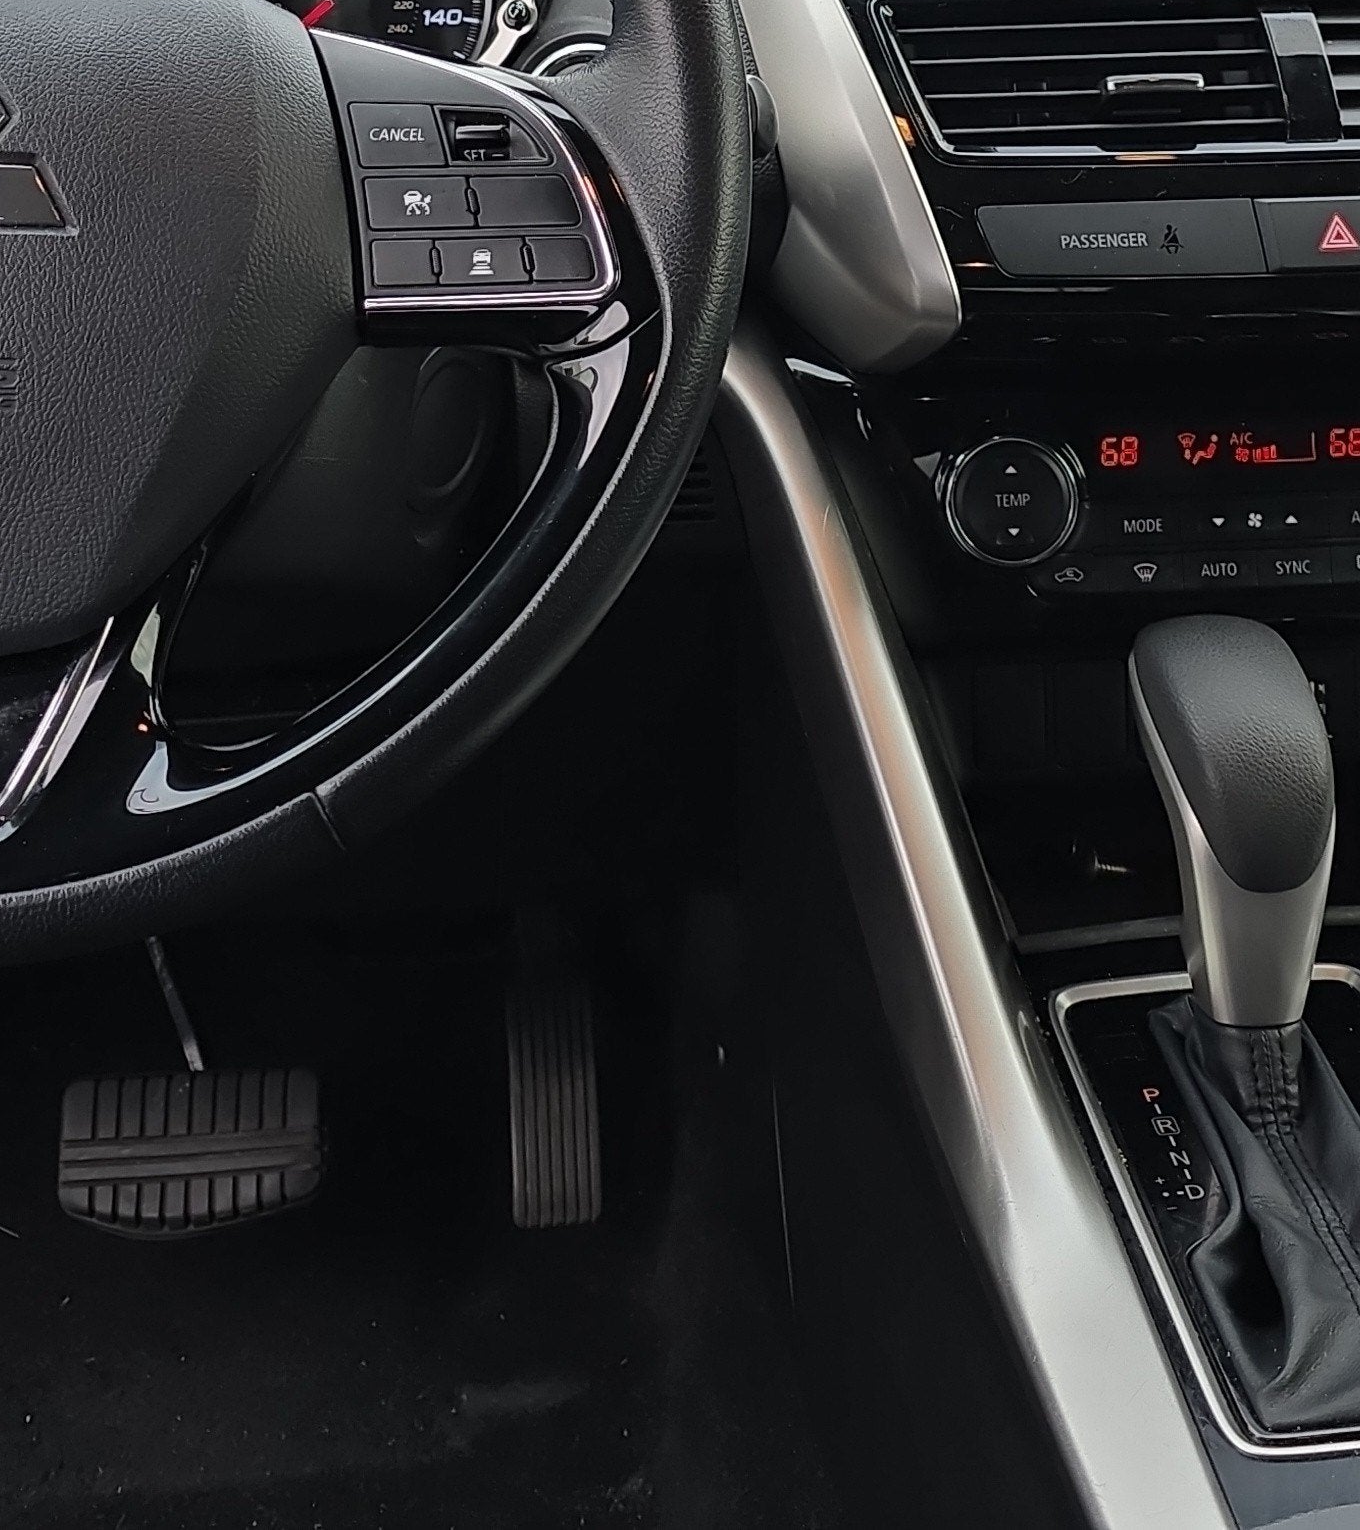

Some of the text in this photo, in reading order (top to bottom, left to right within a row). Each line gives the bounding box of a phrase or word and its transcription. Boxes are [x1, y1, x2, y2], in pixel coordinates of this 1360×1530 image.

[393, 1, 414, 10] 220
[422, 9, 462, 26] 140
[387, 24, 408, 34] 240
[369, 128, 425, 142] CANCEL
[1060, 232, 1148, 250] PASSENGER
[1229, 432, 1253, 445] A/C
[1100, 436, 1139, 466] 68
[995, 493, 1031, 508] TEMP
[1123, 518, 1164, 533] MODE
[1201, 562, 1238, 577] AUTO
[1275, 560, 1311, 575] SYNC
[1142, 1088, 1160, 1102] P
[1156, 1119, 1177, 1133] R
[1169, 1150, 1191, 1166] N
[1184, 1184, 1205, 1200] D
